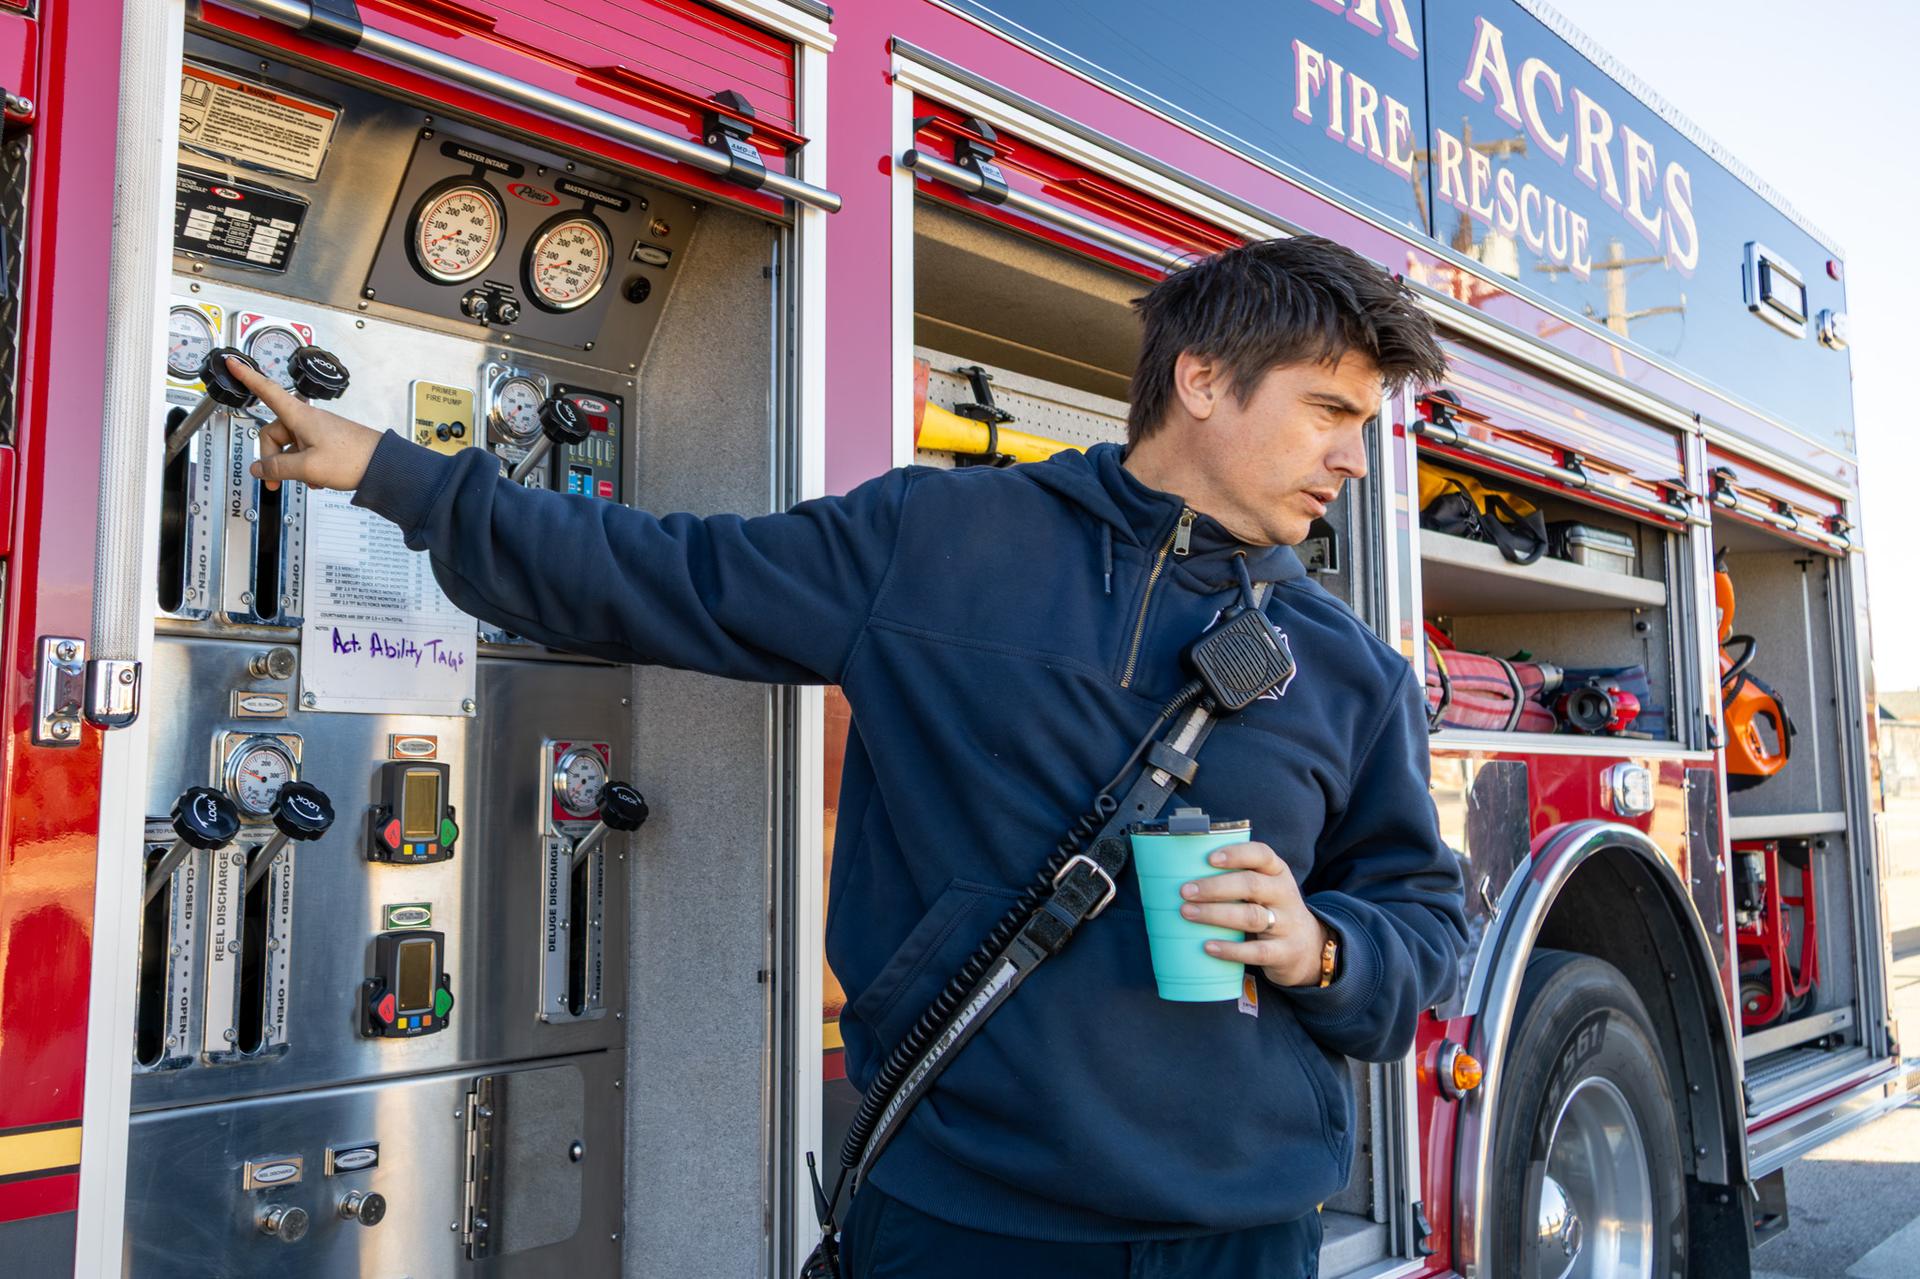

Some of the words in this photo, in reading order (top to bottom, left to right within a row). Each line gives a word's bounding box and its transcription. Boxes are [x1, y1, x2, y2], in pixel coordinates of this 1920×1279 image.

[1459, 15, 1700, 280] ACRES
[457, 148, 486, 163] MASTER
[484, 156, 509, 171] INTAKE
[1292, 38, 1414, 181] FIRE
[1436, 128, 1592, 282] RESCUE
[518, 185, 549, 202] Pierce
[564, 183, 589, 197] MASTER
[589, 190, 623, 206] DISCHARGE
[446, 207, 460, 217] 200
[461, 203, 475, 213] 300
[434, 221, 448, 230] 100
[470, 216, 484, 226] 400
[468, 233, 482, 243] 500
[557, 238, 571, 248] 200
[572, 235, 585, 245] 300
[456, 247, 470, 257] 600
[546, 250, 559, 260] 100
[580, 248, 593, 257] 400
[577, 264, 590, 273] 500
[566, 276, 579, 286] 600
[313, 356, 337, 372] LOCK
[426, 393, 442, 403] FIRE
[442, 397, 463, 406] PUMP
[431, 385, 457, 396] PRIMER
[563, 404, 577, 422] LOCK
[203, 432, 212, 482] CLOSED
[233, 424, 245, 487] CROSSLAY
[231, 489, 242, 518] NO.2
[198, 554, 208, 590] OPEN
[291, 563, 300, 598] OPEN
[332, 626, 362, 655] Act.
[370, 632, 423, 668] Ability
[295, 794, 321, 812] LOCK
[618, 793, 638, 806] LOCK
[207, 799, 217, 823] LOCK
[550, 843, 559, 906] DISCHARGE
[185, 867, 195, 920] CLOSED
[216, 852, 229, 926] DISCHARGE
[281, 865, 290, 915] CLOSED
[549, 908, 558, 952] DELUGE
[215, 929, 226, 962] REEL
[179, 996, 188, 1034] OPEN
[277, 988, 285, 1024] OPEN
